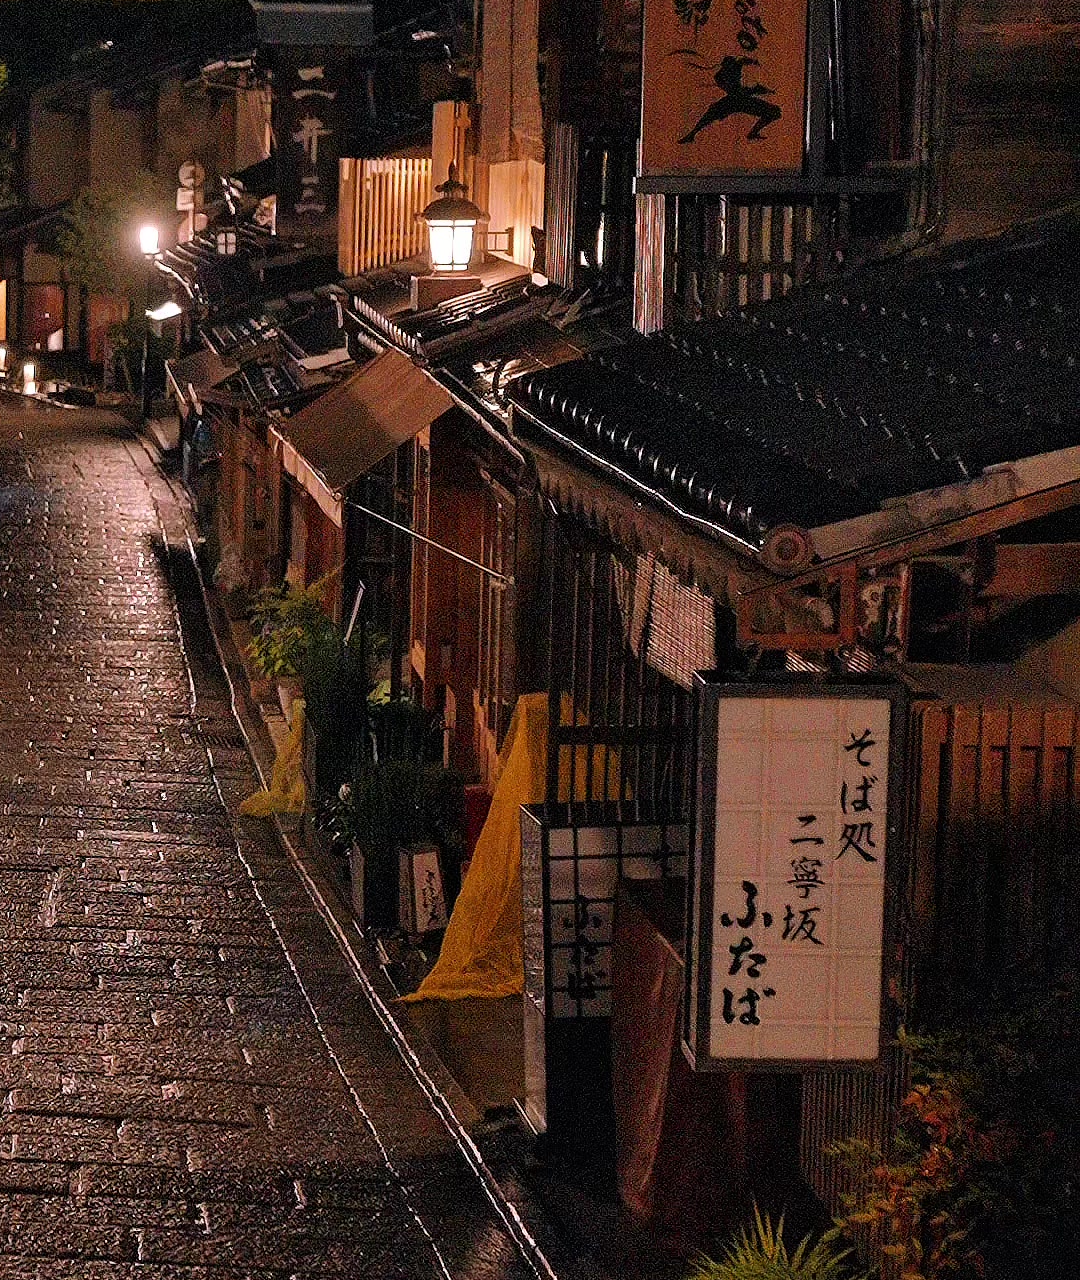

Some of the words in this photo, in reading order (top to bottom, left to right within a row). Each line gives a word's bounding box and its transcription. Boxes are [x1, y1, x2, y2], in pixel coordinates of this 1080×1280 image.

[835, 728, 878, 863] そば処
[781, 814, 825, 946] 二寧坂
[719, 879, 777, 1026] ふたば
